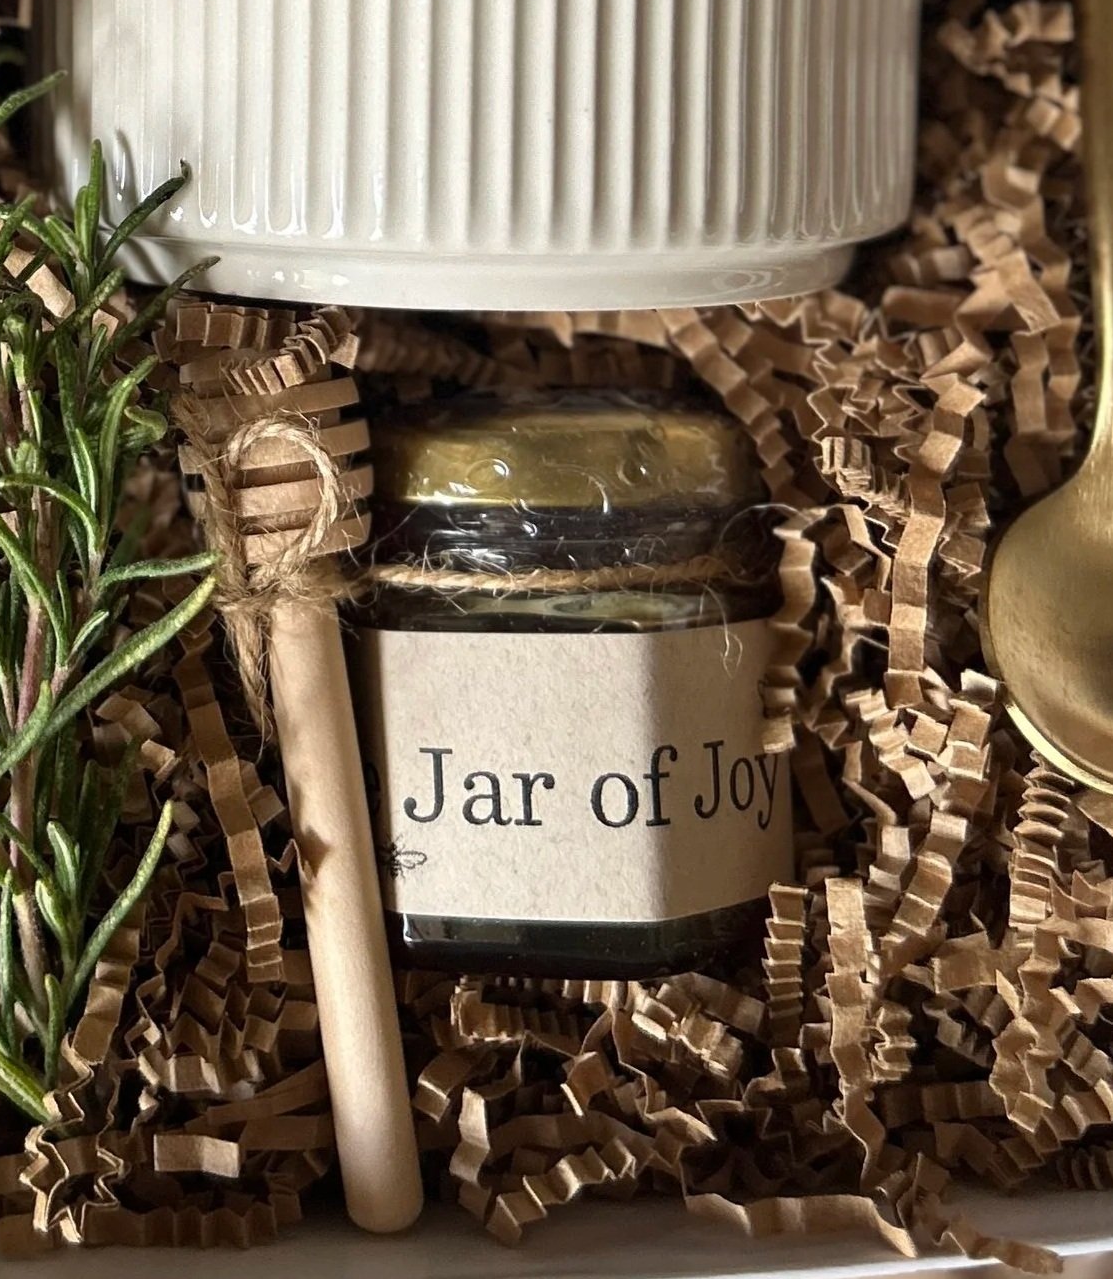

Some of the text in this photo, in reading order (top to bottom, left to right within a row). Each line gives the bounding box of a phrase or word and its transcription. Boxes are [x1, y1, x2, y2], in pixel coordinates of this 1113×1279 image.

[403, 746, 555, 827] Jar
[590, 744, 679, 828] of
[693, 740, 780, 831] Joy
